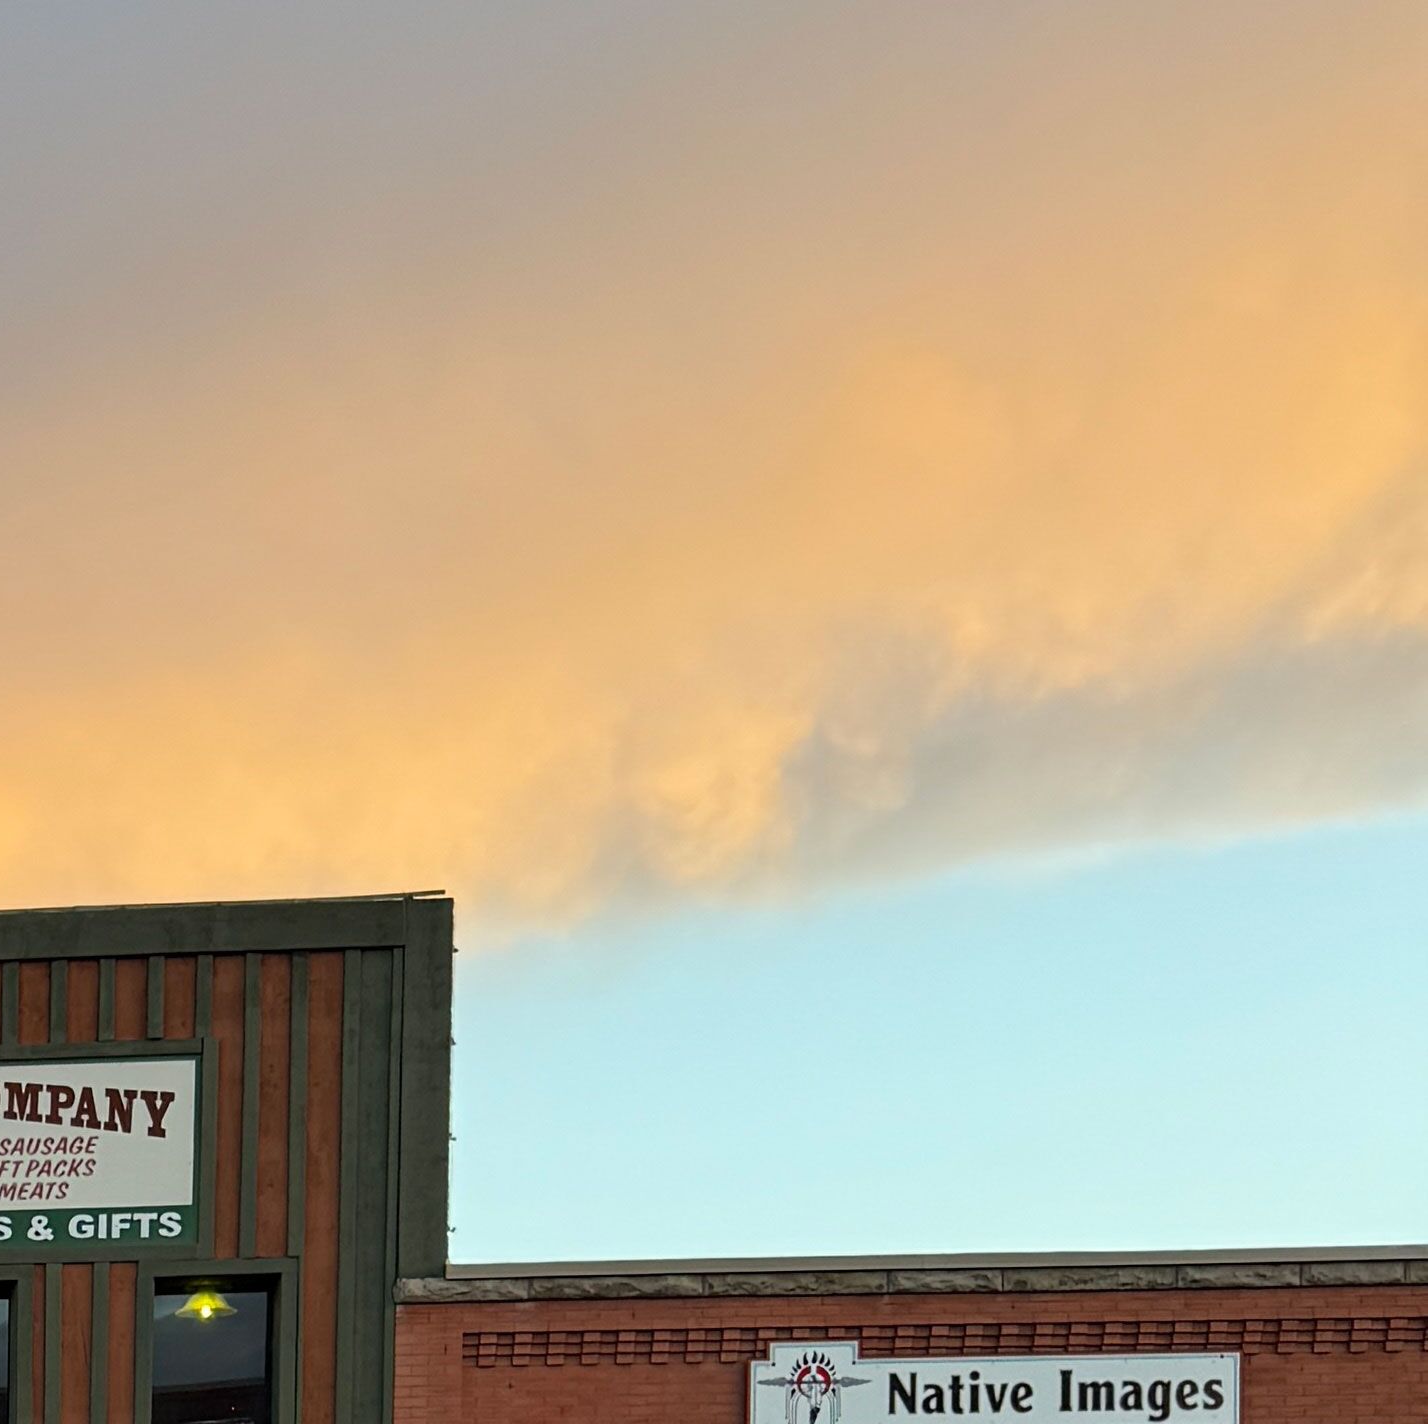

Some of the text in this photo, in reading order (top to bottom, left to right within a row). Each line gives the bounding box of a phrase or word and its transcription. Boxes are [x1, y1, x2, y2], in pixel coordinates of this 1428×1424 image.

[26, 1159, 96, 1179] PACKS
[27, 1215, 55, 1242] &
[68, 1212, 182, 1239] GIFTS
[888, 1369, 1225, 1422] Native Images
